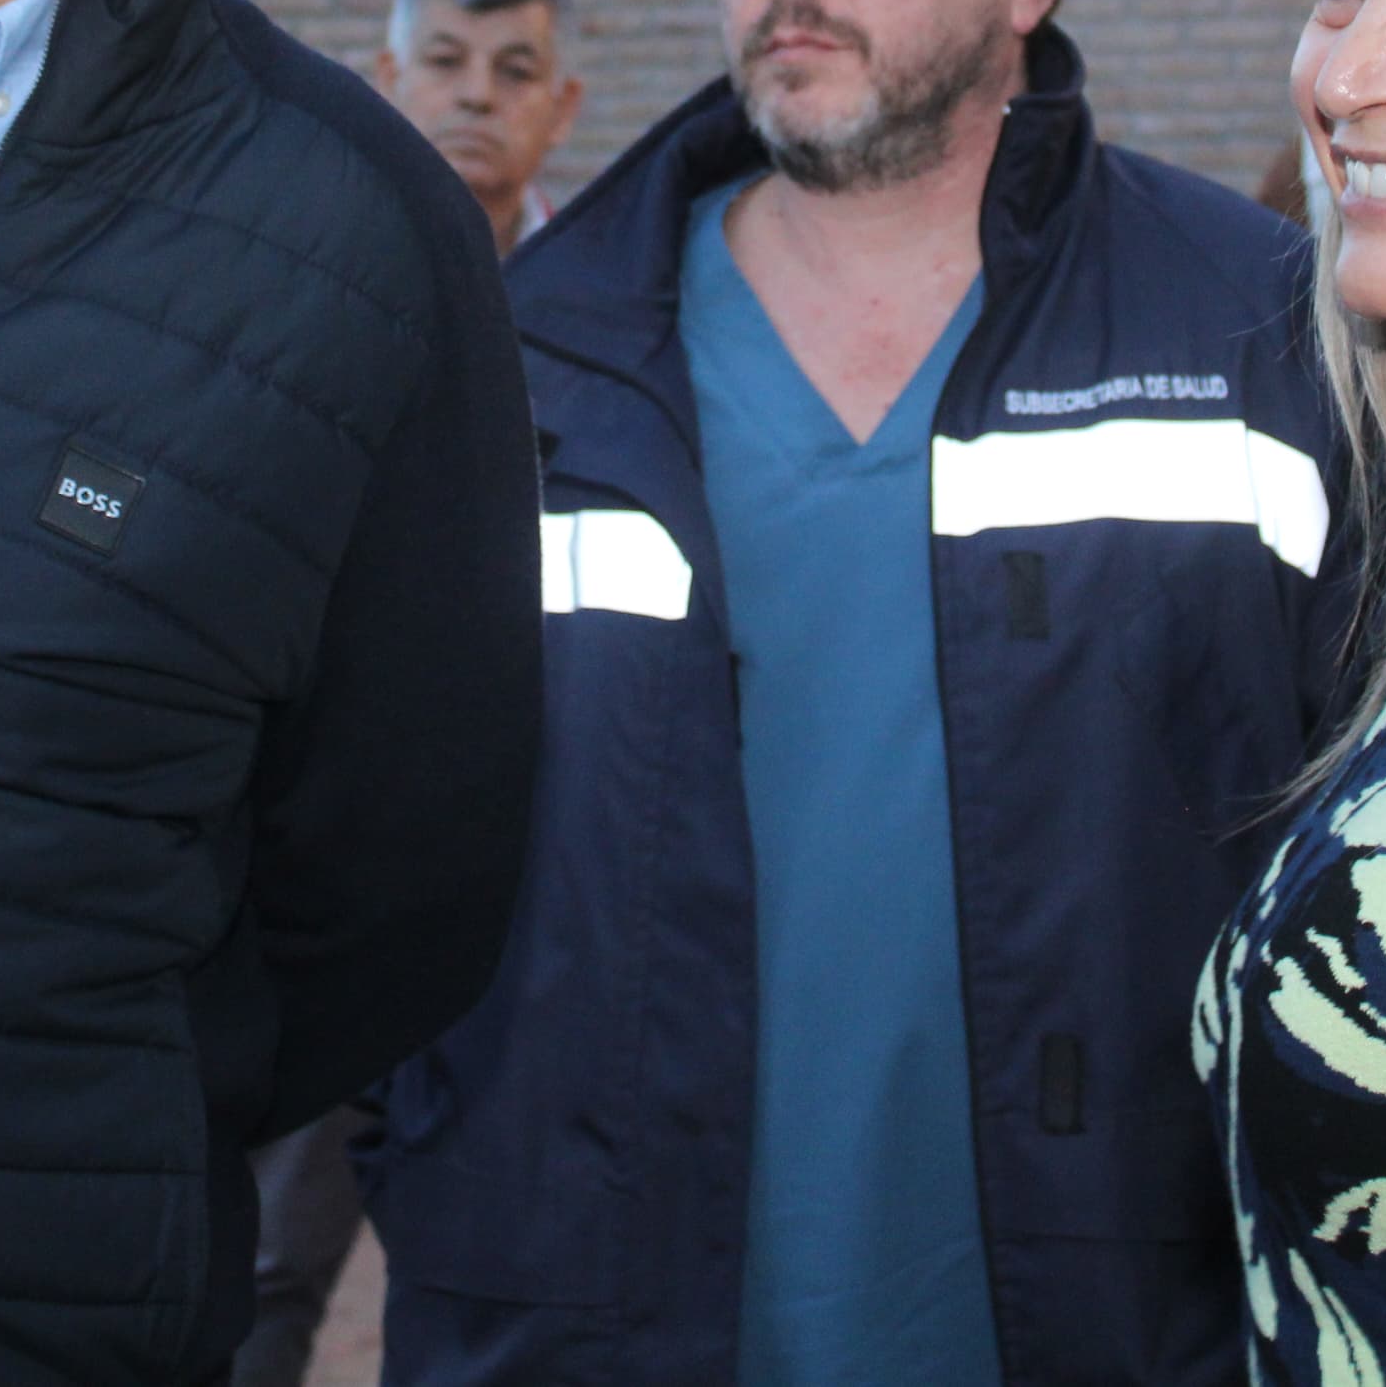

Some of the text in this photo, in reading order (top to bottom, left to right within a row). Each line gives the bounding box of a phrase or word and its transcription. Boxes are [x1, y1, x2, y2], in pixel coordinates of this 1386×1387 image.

[1004, 374, 1228, 414] SUBSECRETARIA DE SALUD
[58, 477, 122, 518] BOSS
